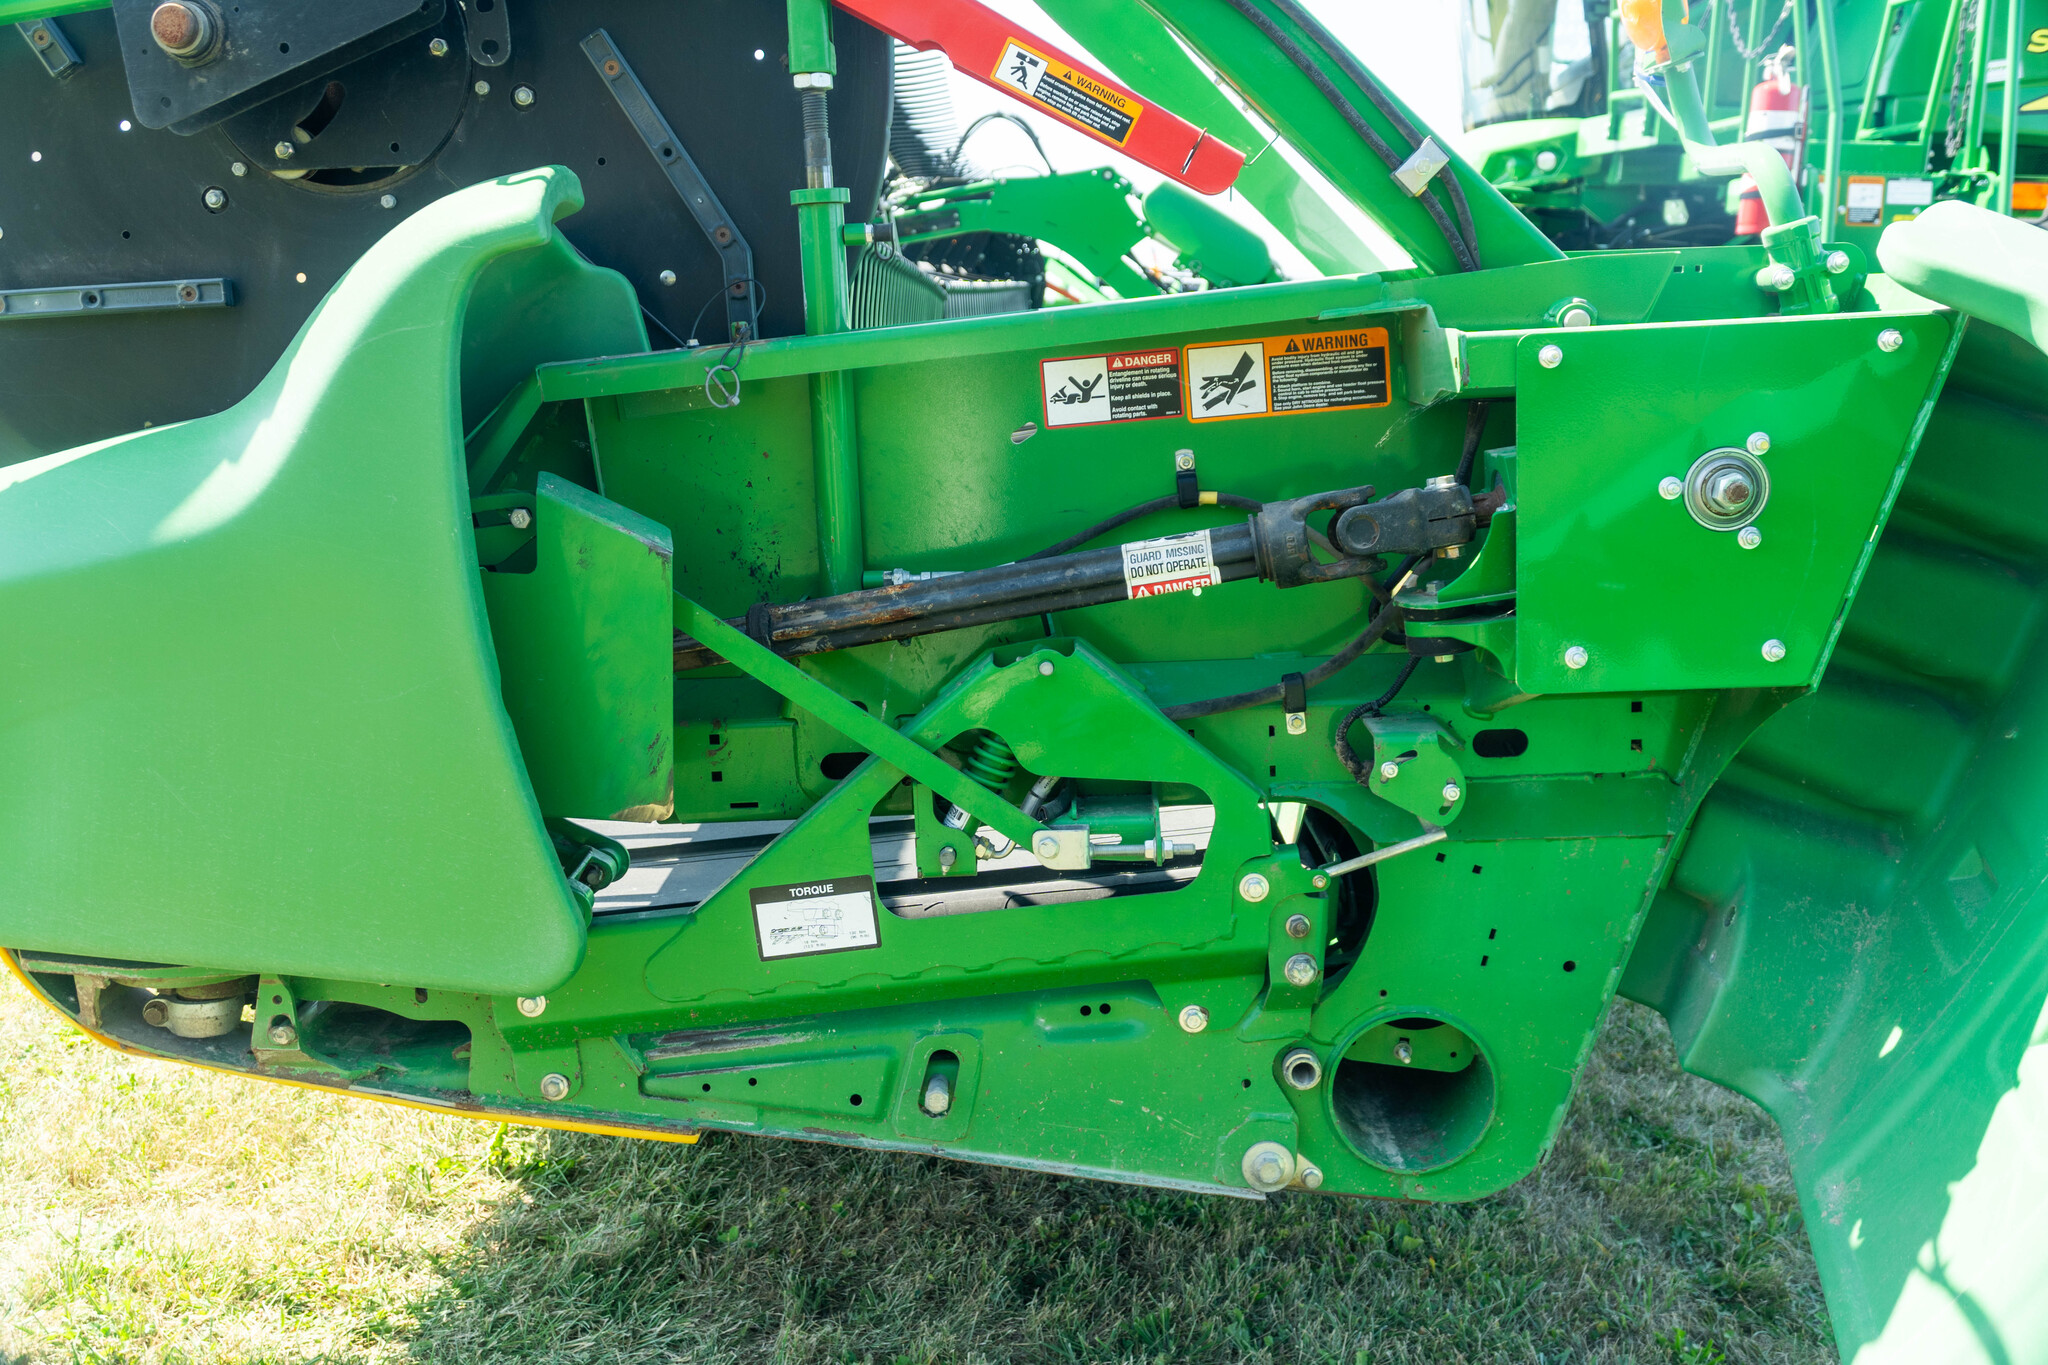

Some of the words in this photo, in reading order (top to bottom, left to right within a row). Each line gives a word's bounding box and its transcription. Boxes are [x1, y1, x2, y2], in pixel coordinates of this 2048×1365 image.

[1043, 75, 1055, 83] Avoid
[1054, 81, 1072, 93] crushing
[1076, 76, 1126, 108] WARNING
[1302, 334, 1368, 352] WARNING
[1125, 354, 1171, 367] DANGER
[1109, 369, 1144, 378] Entanglement
[1130, 550, 1162, 564] GUARD
[1166, 544, 1204, 559] MISSING
[1130, 566, 1144, 578] DO
[1146, 563, 1164, 576] NOT
[1166, 556, 1207, 575] OPERATE
[789, 884, 834, 897] TORQUE
